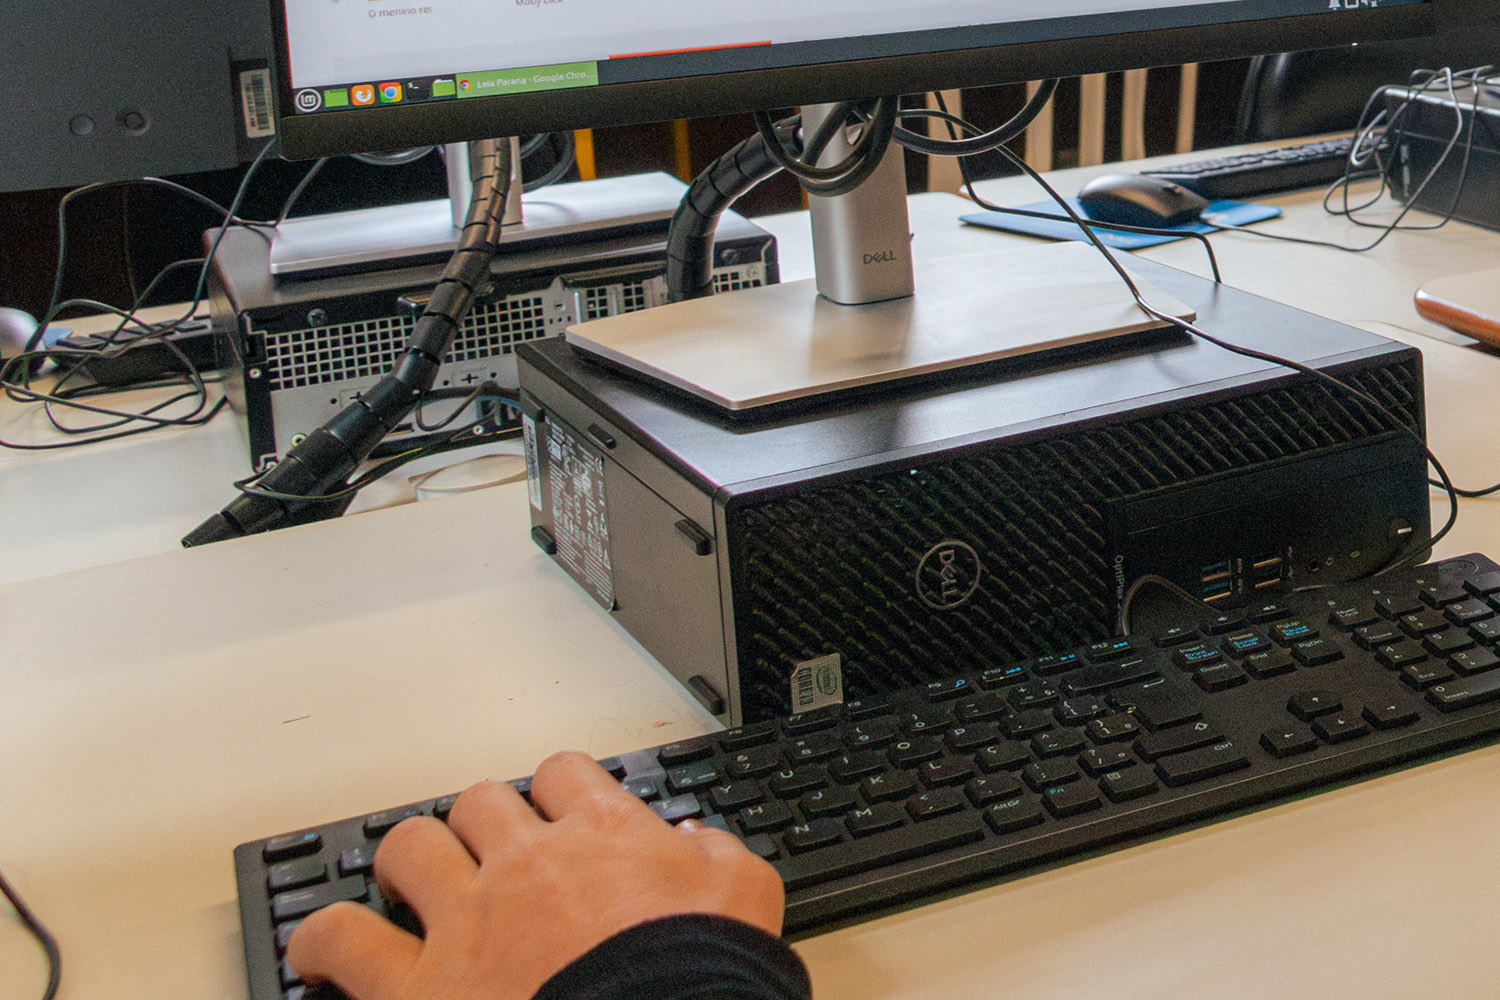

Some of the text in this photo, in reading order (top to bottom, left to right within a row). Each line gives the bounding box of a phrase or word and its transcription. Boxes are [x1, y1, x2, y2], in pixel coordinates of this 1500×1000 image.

[379, 7, 417, 17] menino
[419, 6, 432, 15] rei
[477, 73, 564, 88] Leia Google
[864, 251, 896, 264] DELL
[1214, 742, 1232, 751] Ctrl
